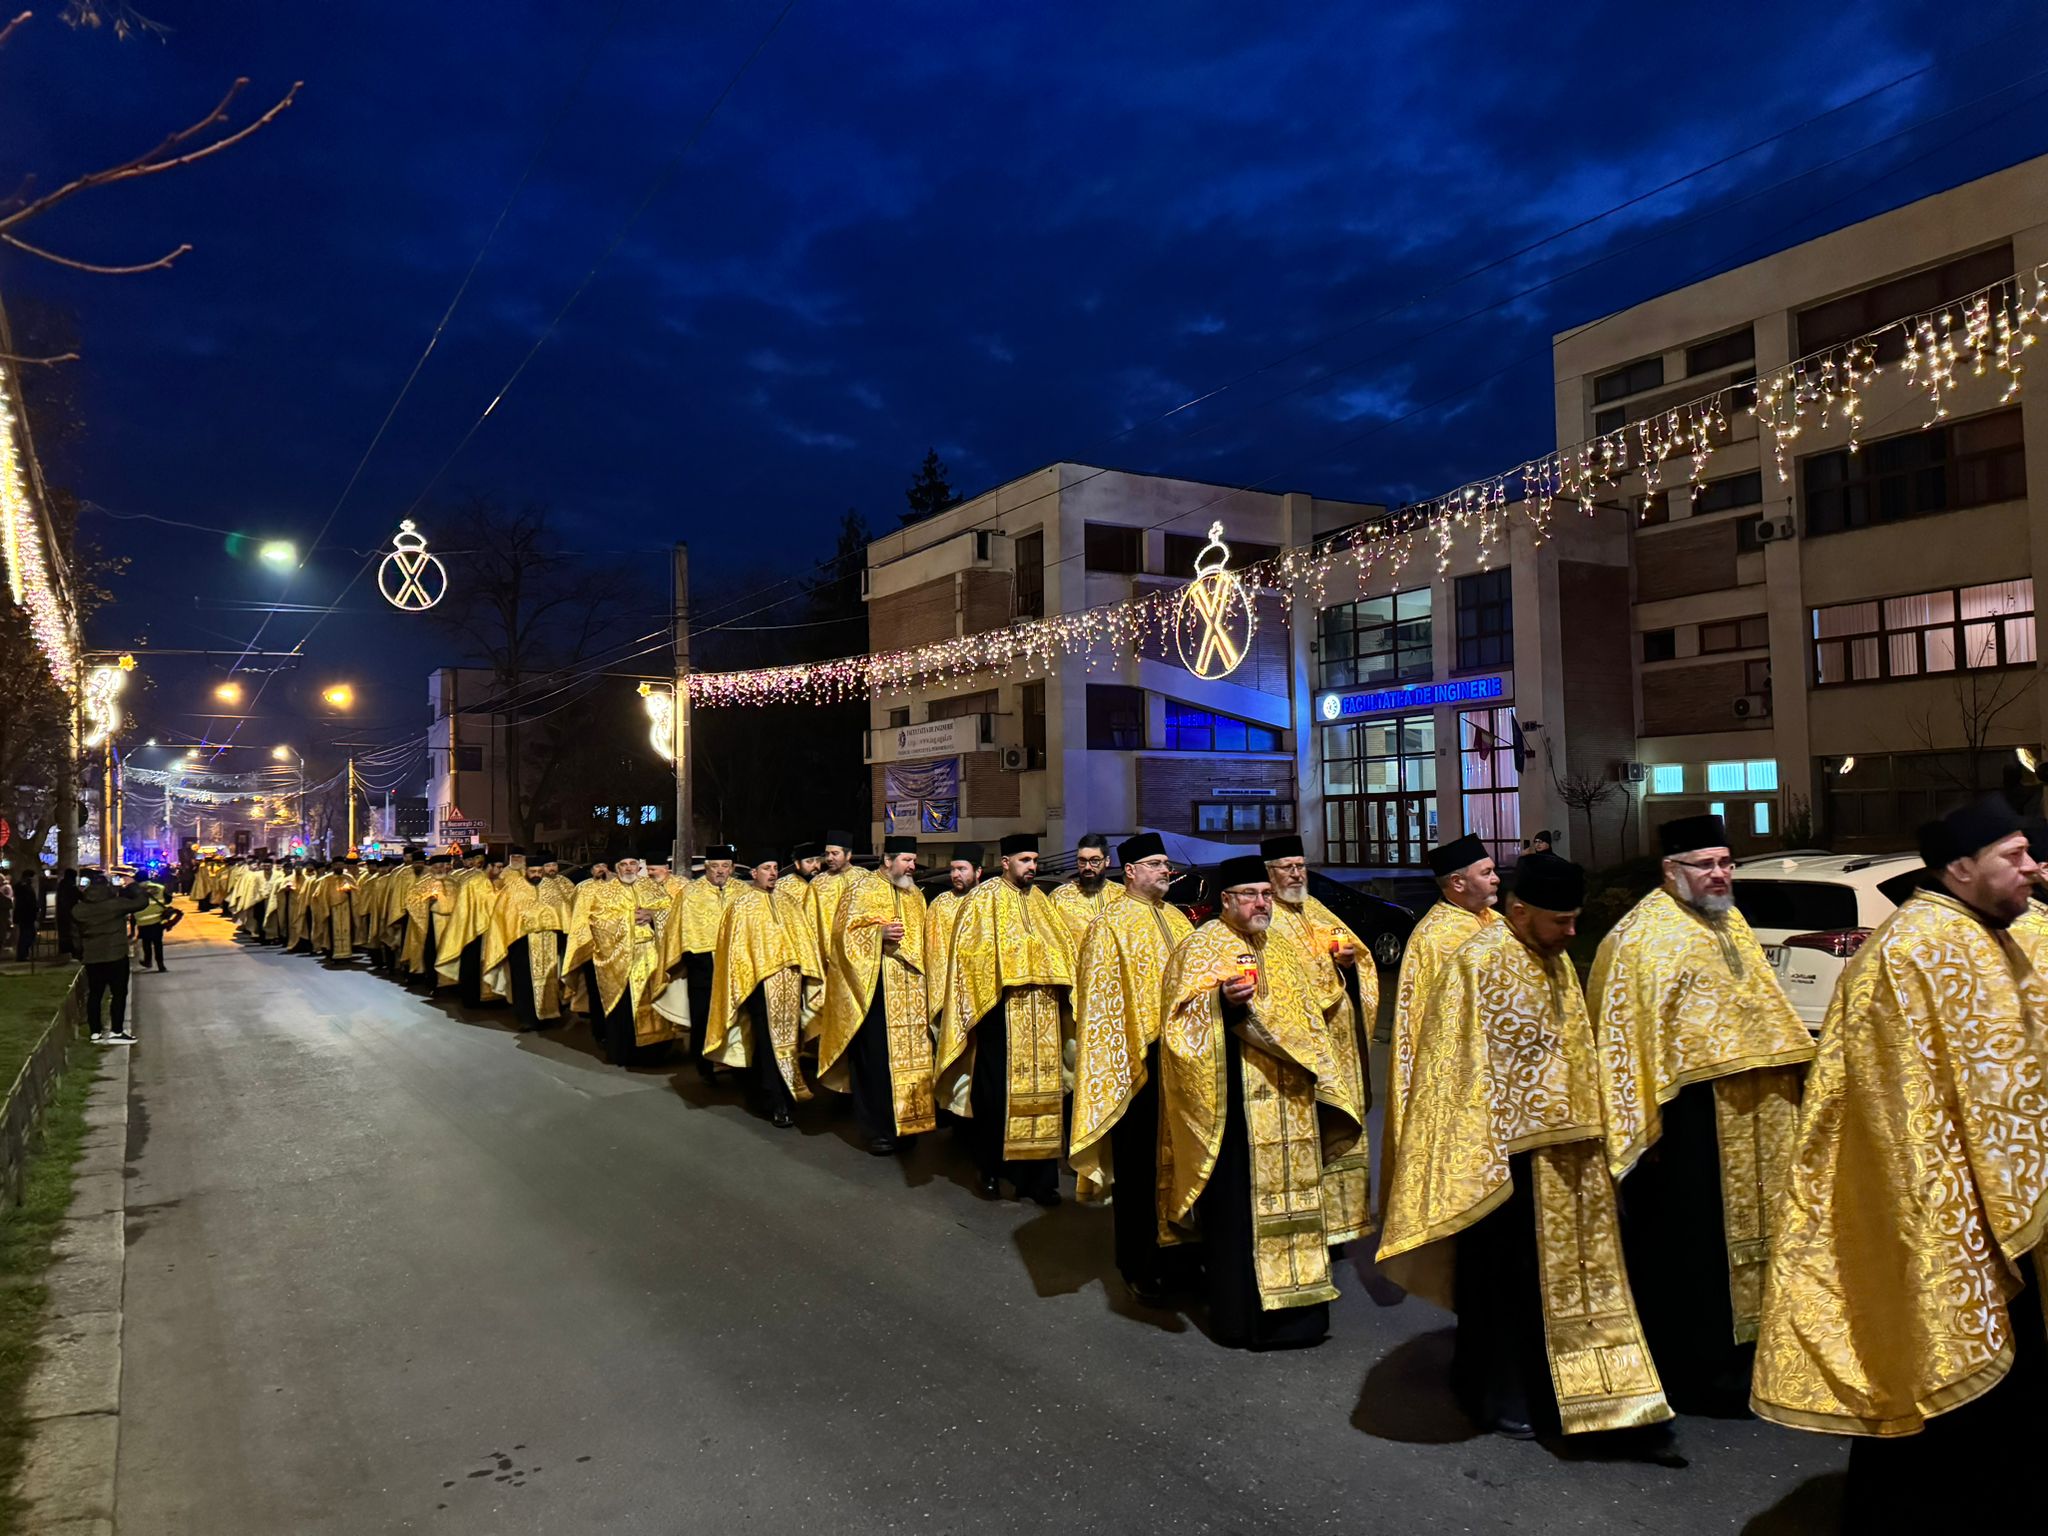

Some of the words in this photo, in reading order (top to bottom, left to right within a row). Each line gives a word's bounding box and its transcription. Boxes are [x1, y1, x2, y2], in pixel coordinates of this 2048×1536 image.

[1343, 691, 1412, 714] FACULTATEA
[1415, 686, 1432, 705] DE
[1434, 677, 1502, 702] INGINERIE
